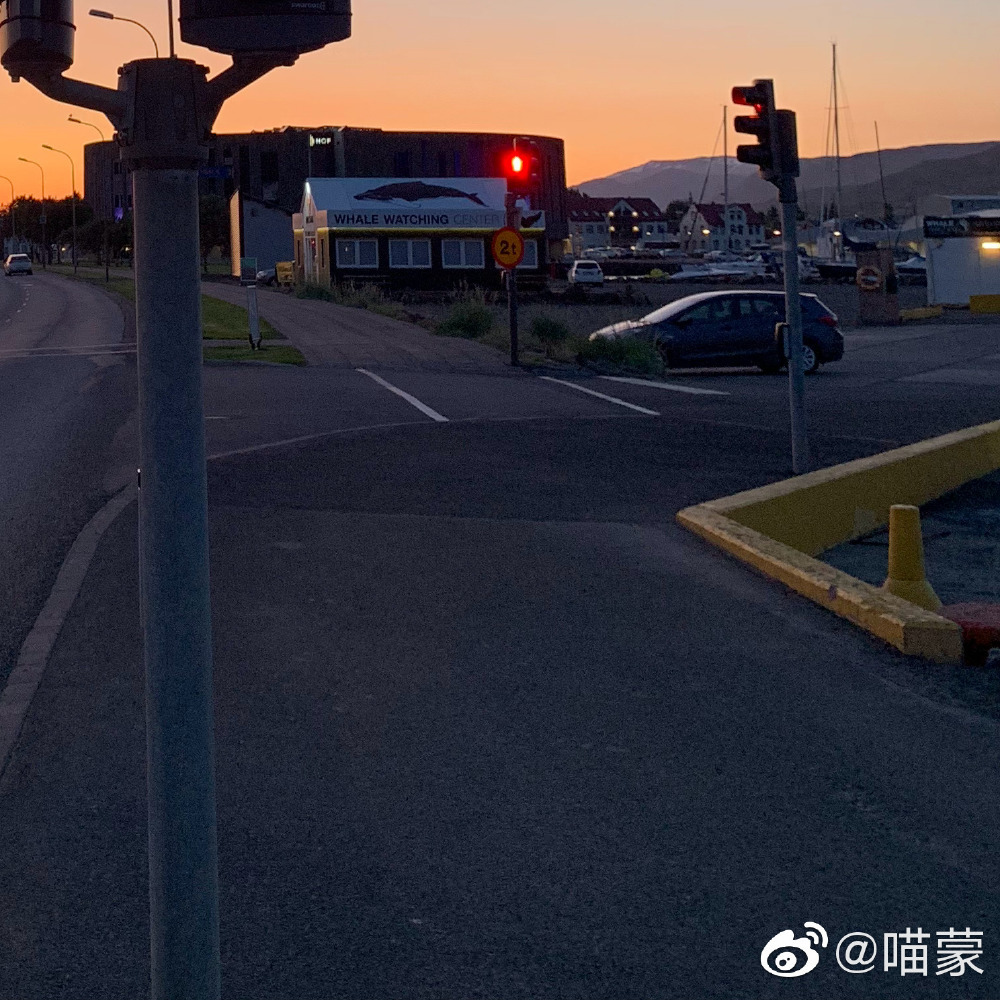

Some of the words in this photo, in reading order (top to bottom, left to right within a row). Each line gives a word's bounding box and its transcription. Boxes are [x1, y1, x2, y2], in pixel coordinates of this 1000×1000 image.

[334, 213, 379, 225] WHALE
[383, 213, 449, 225] WATCHING
[453, 213, 500, 225] CENTER
